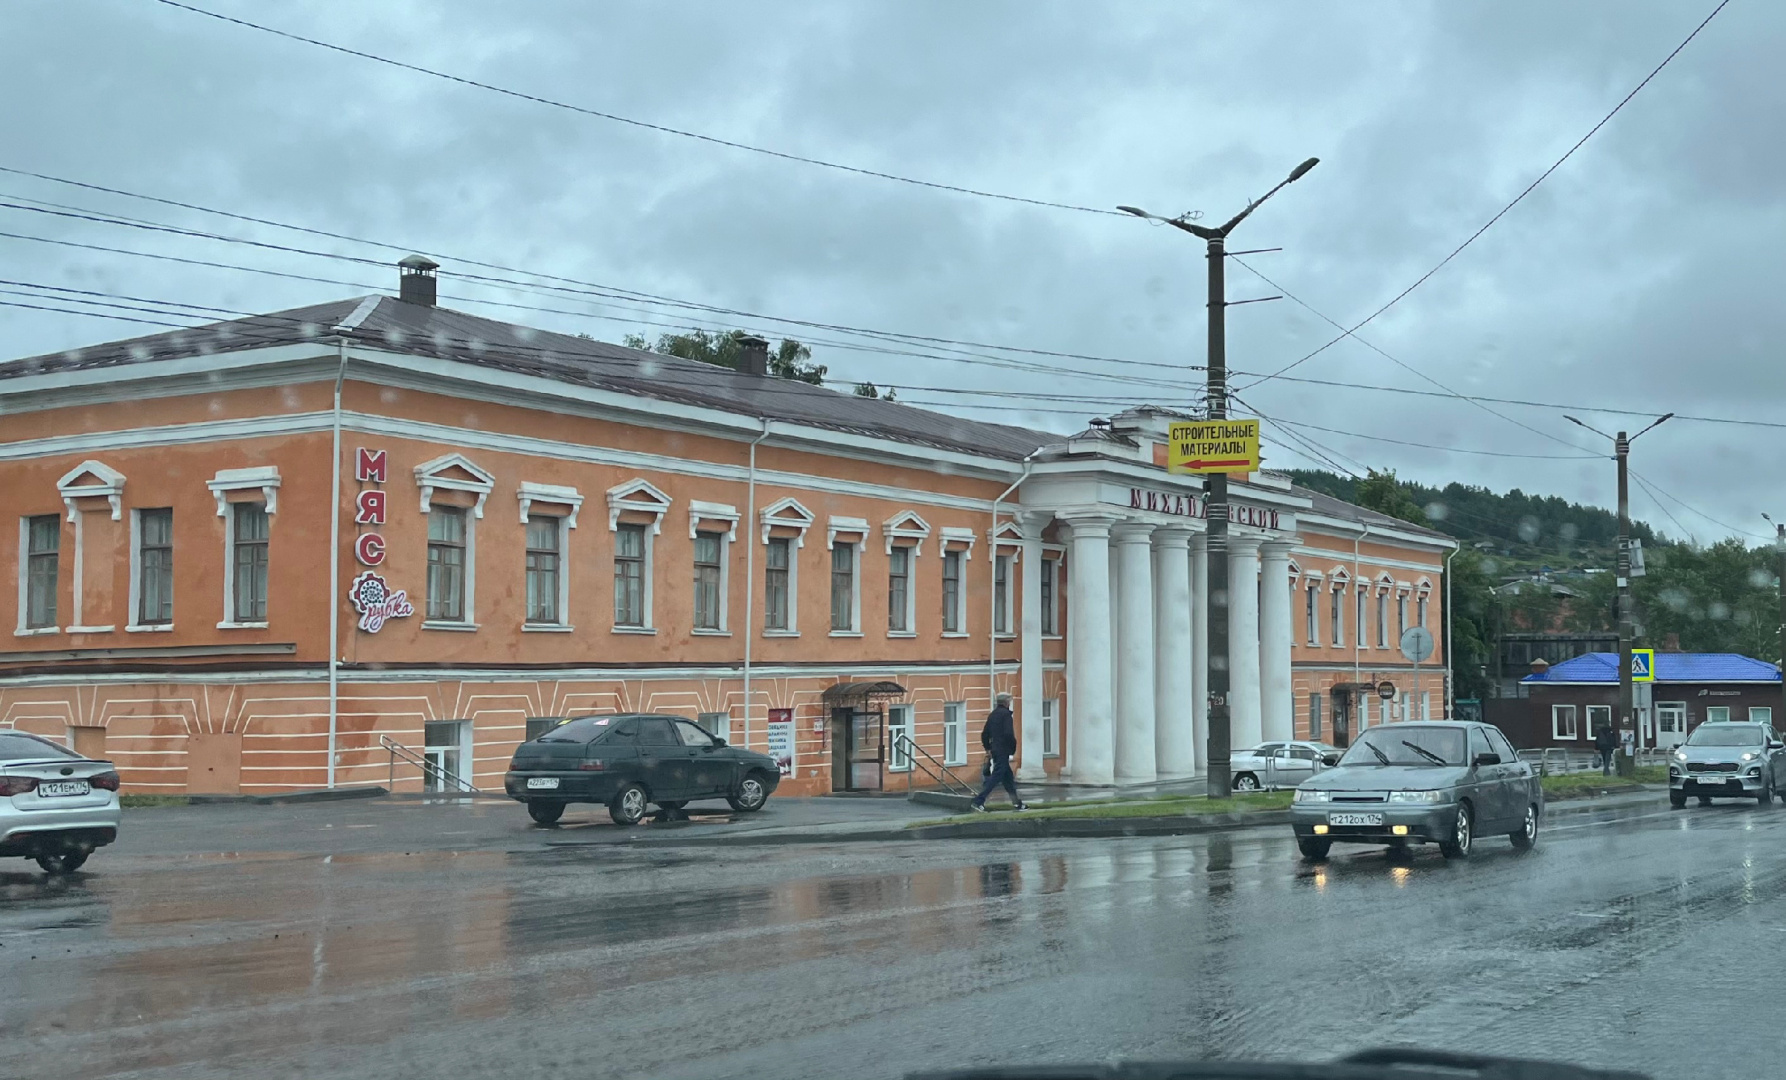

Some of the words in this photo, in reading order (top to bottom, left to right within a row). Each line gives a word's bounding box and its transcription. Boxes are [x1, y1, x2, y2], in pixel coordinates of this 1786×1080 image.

[1172, 424, 1254, 441] СТРОИТЕЛЬНЫЕ
[1181, 441, 1246, 456] МАТЕРИАЛЫ
[1131, 488, 1280, 529] МИХАЙВСКИЙ
[363, 592, 413, 631] рубка
